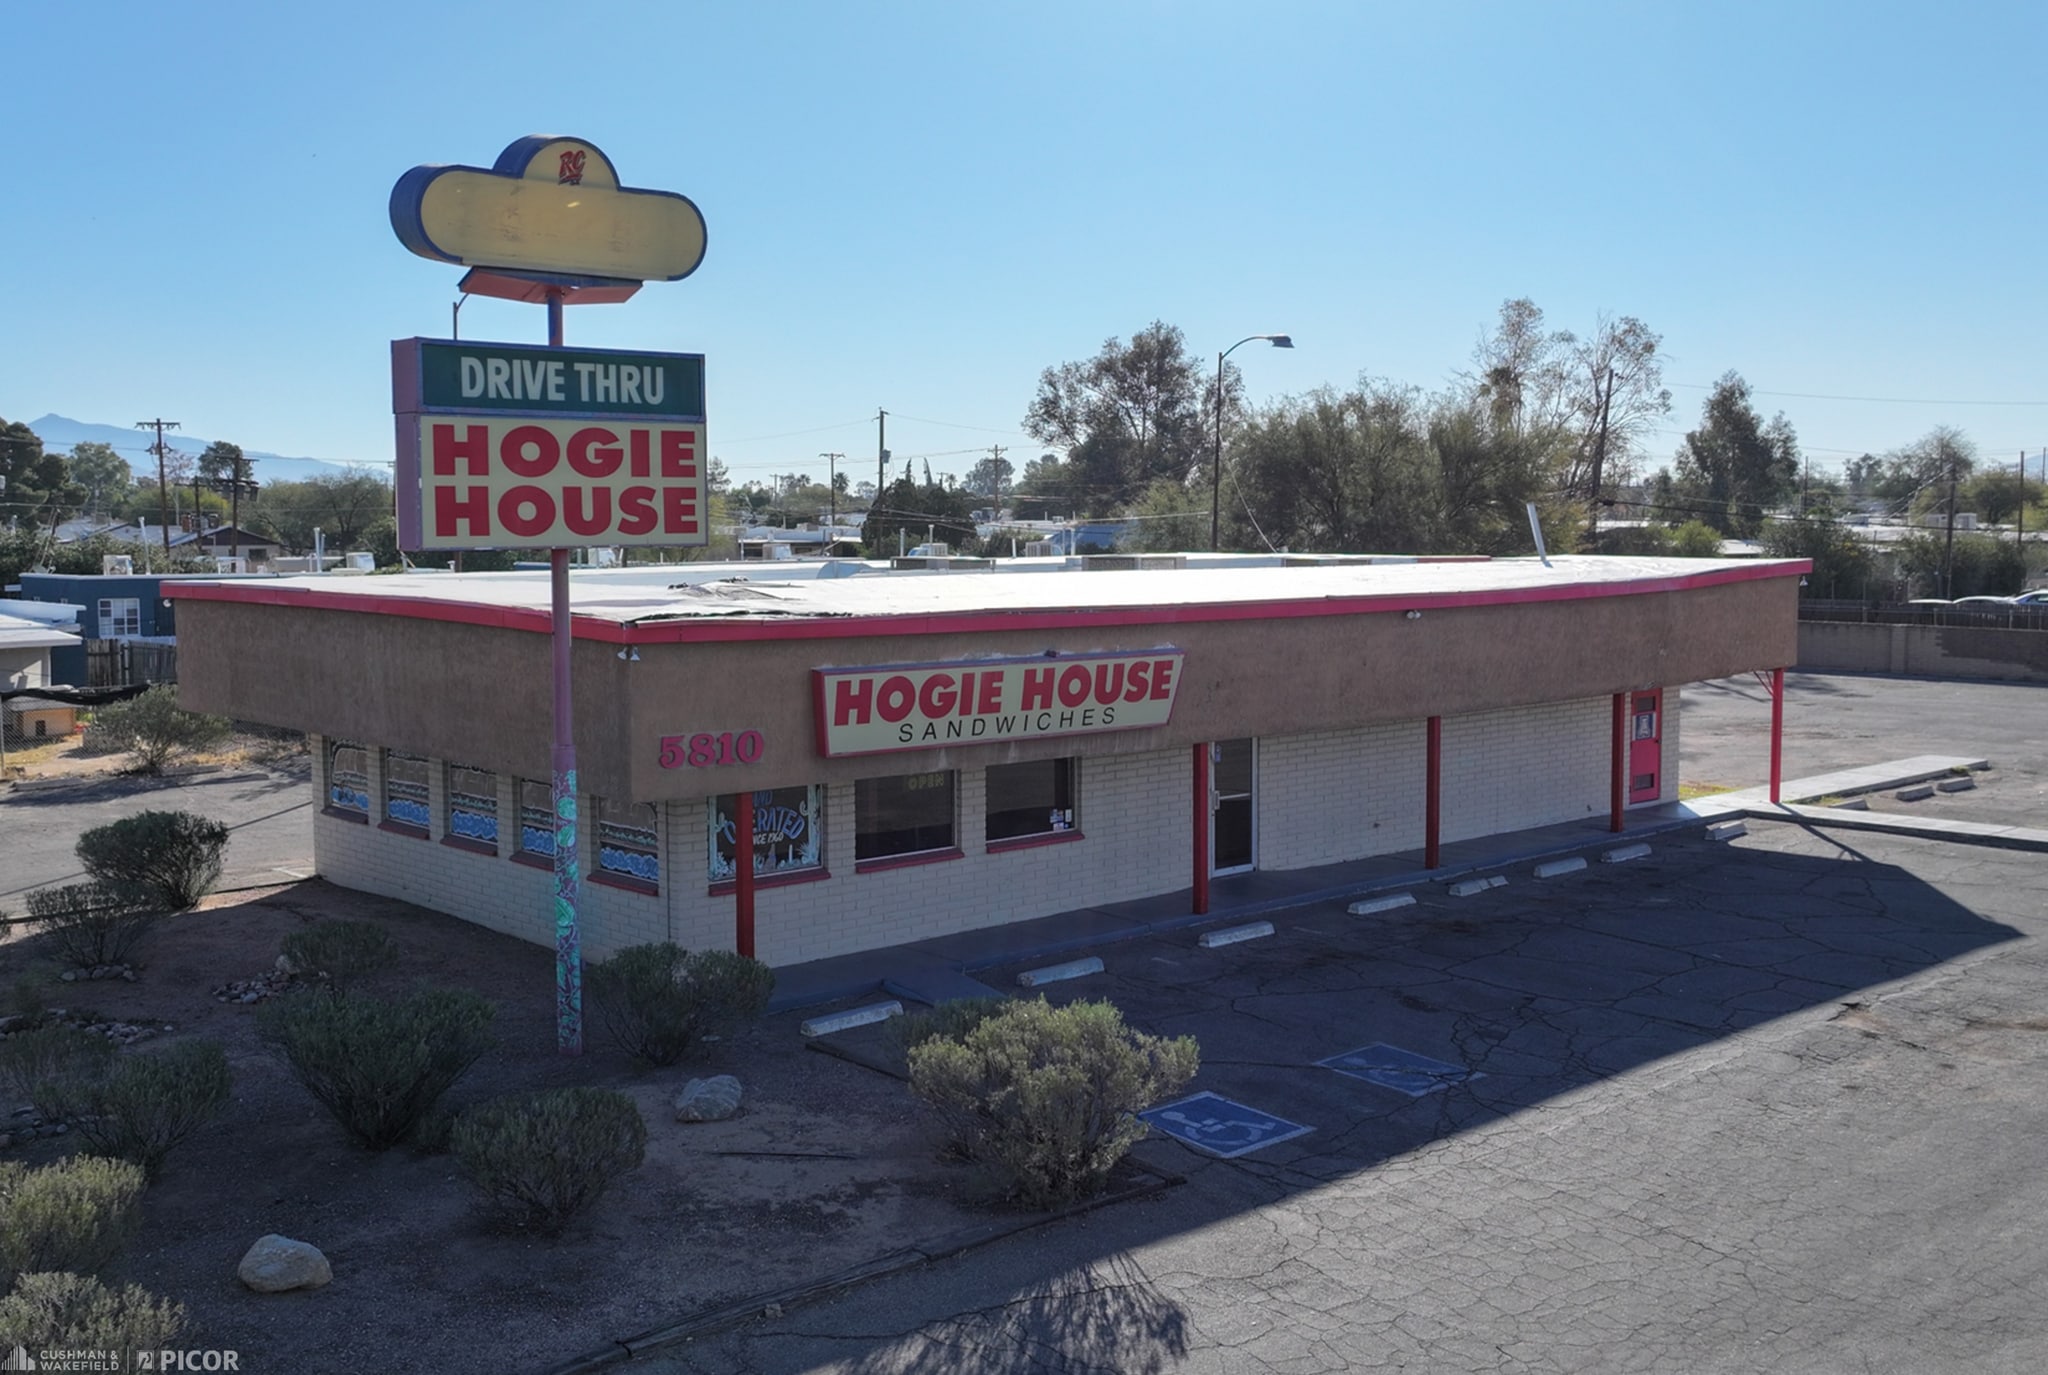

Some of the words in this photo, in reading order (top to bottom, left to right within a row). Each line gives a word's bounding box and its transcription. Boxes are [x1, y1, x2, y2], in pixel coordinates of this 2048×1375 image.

[559, 150, 586, 177] RC
[460, 356, 565, 401] DRIVE
[574, 363, 665, 405] THRU
[432, 424, 697, 478] HOGIE
[434, 485, 698, 537] HOUSE
[833, 671, 1003, 727] HOGIE
[1020, 659, 1174, 712] HOUSE
[898, 707, 1116, 743] SANDWICHES
[659, 730, 764, 769] 5810
[752, 790, 773, 807] ND
[908, 774, 944, 790] OPEN
[723, 806, 805, 845] ORATED
[752, 833, 767, 845] NCE
